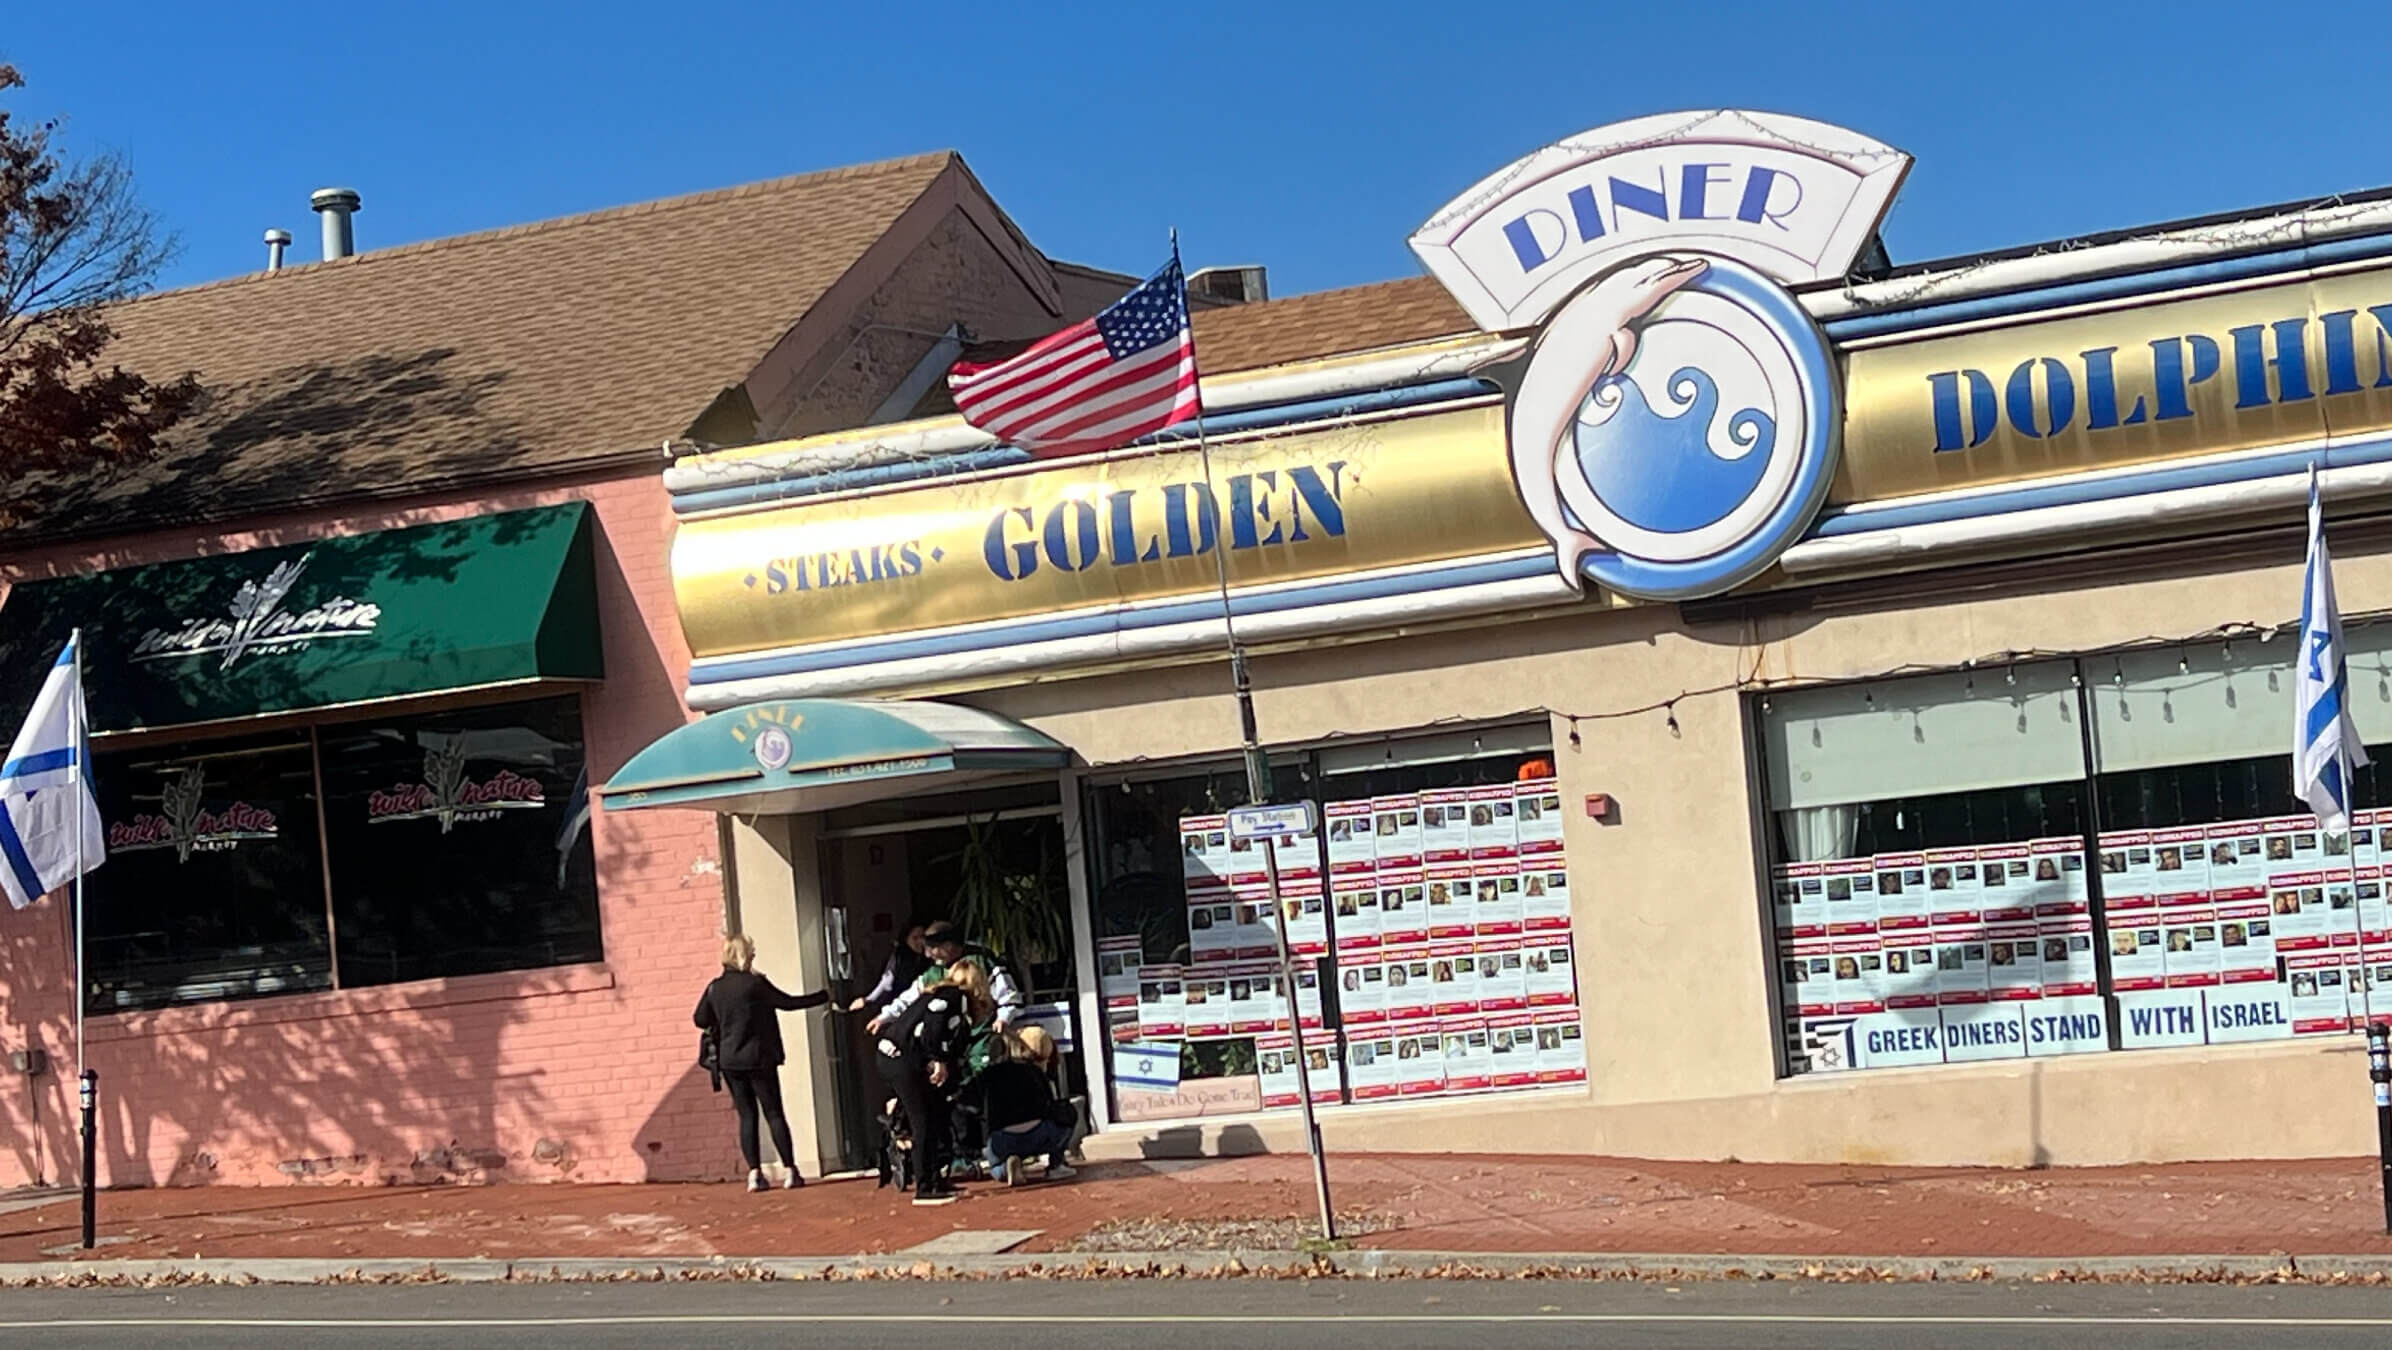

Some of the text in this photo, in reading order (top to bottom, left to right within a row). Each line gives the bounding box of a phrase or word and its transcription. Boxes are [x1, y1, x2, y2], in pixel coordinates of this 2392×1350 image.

[1502, 163, 1804, 274] DINER
[1926, 303, 2392, 454] DOLPHI
[765, 539, 925, 595] STEAKS
[983, 459, 1348, 582] GOLDEN
[1868, 1001, 2288, 1054] GREEK DINERS STAND WITH ISRAEL
